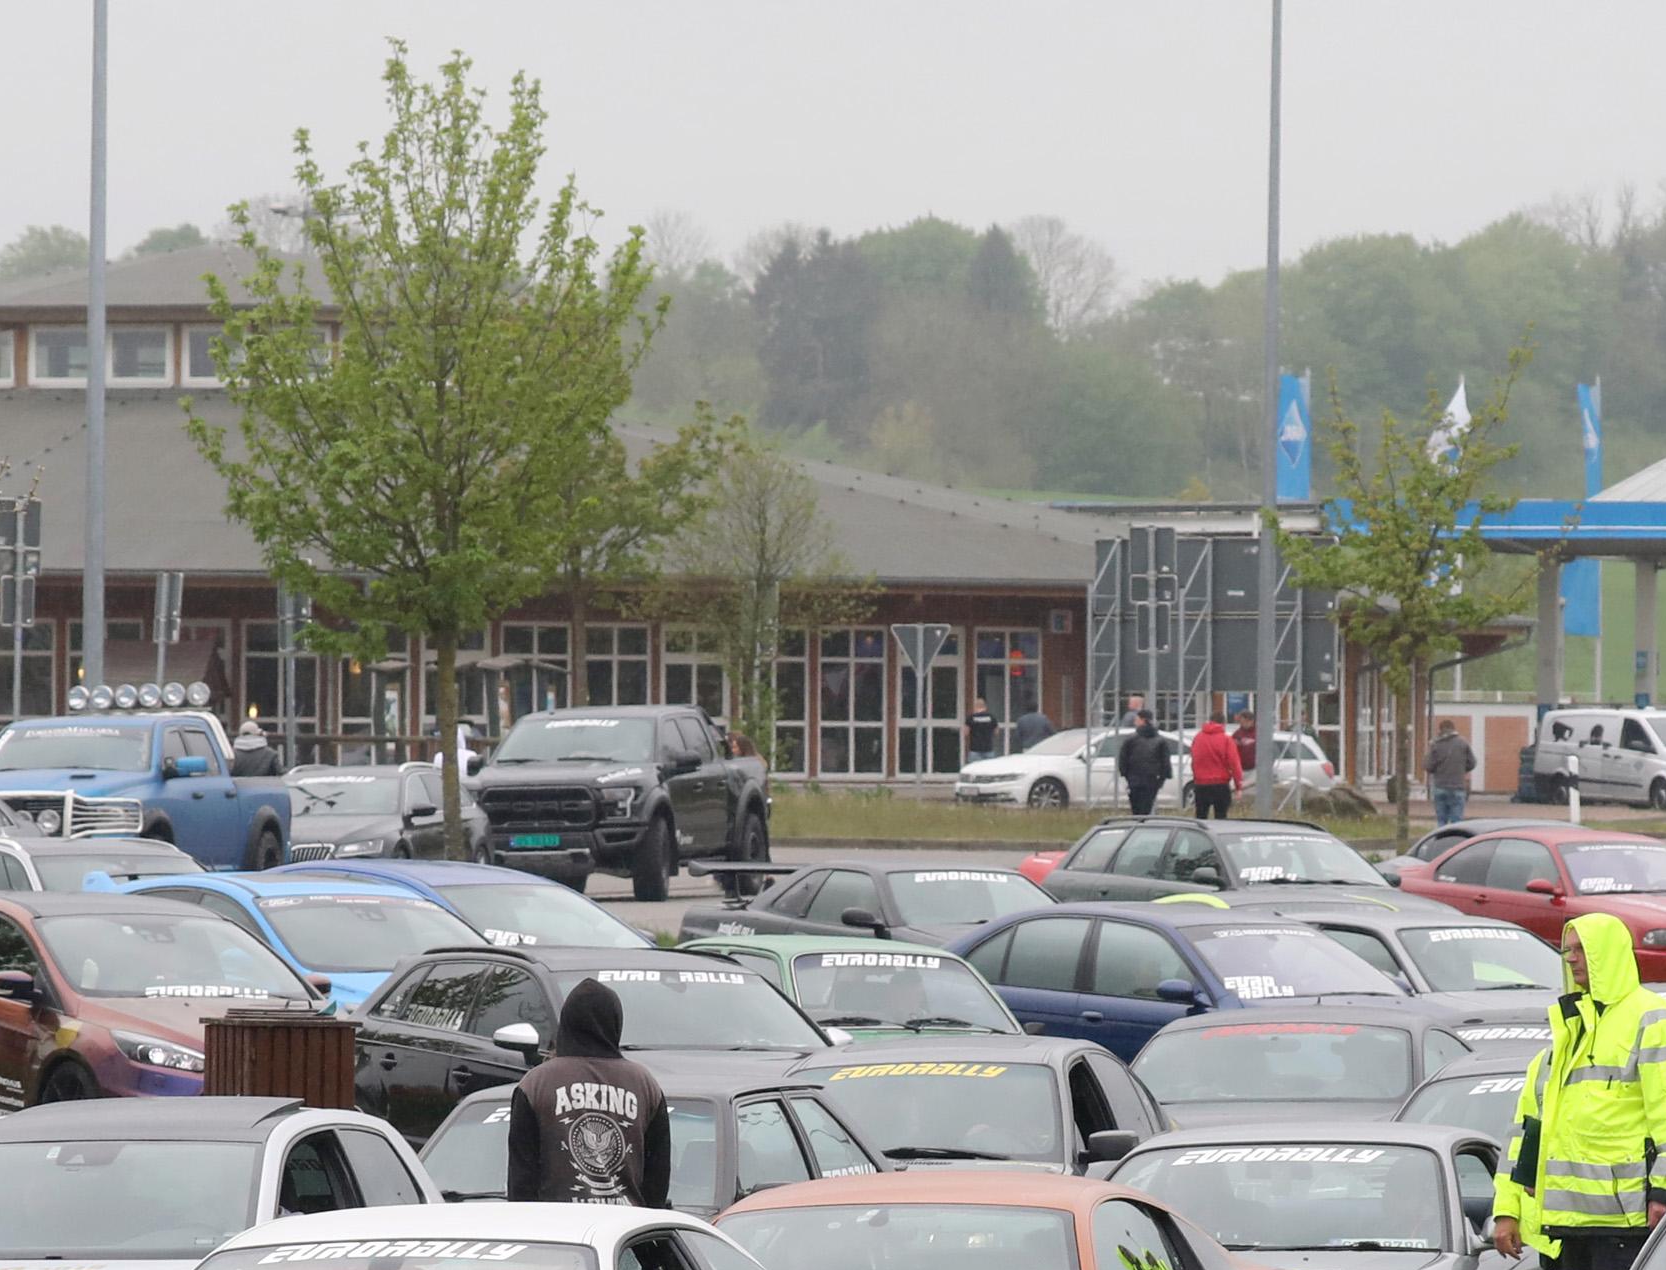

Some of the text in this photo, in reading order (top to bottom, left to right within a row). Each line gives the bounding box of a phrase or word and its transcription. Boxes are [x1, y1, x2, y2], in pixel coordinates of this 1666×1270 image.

[821, 954, 941, 969] EURORALLY
[597, 969, 745, 985] EURO RALLY
[829, 1062, 1008, 1081] EURORALLY
[554, 1081, 638, 1121] ASKING
[1172, 1147, 1386, 1166] EURORALLY
[258, 1241, 528, 1265] EURORALLY
